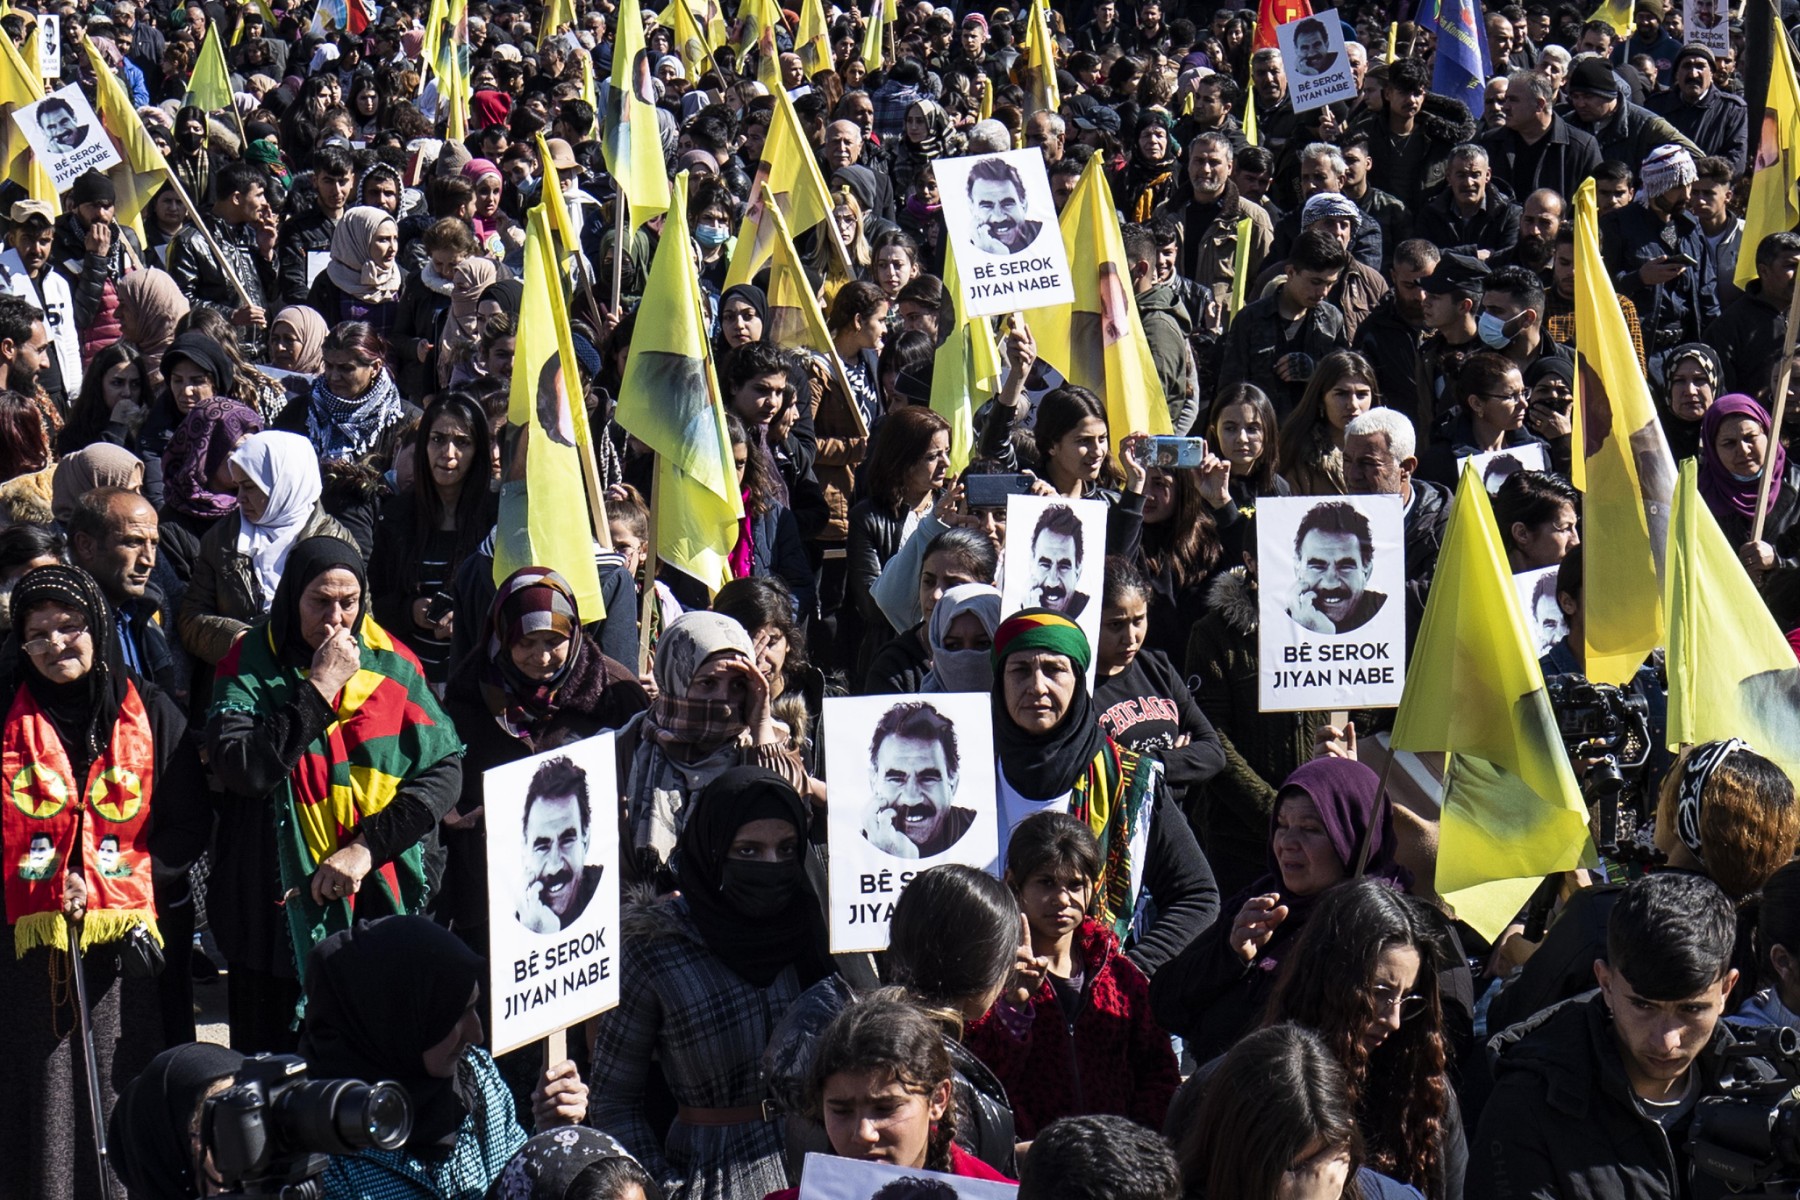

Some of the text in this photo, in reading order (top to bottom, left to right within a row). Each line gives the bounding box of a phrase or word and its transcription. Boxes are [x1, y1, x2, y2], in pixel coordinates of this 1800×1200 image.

[1296, 81, 1349, 104] JIYAN NABE
[1298, 72, 1345, 92] BÊ SEROK
[54, 142, 103, 171] BÊ SEROK
[55, 150, 111, 183] JIYAN NABE
[973, 256, 1054, 280] BÊ SEROK
[969, 274, 1061, 300] JIYAN NABE
[1284, 641, 1390, 663] BÊ SEROK
[1273, 666, 1394, 689] JIYAN NABE
[860, 868, 894, 894] BÊ
[848, 902, 896, 925] JIYA
[514, 926, 606, 983] BÊ SEROK
[504, 956, 610, 1020] JIYAN NABE
[1707, 1157, 1736, 1173] SONY
